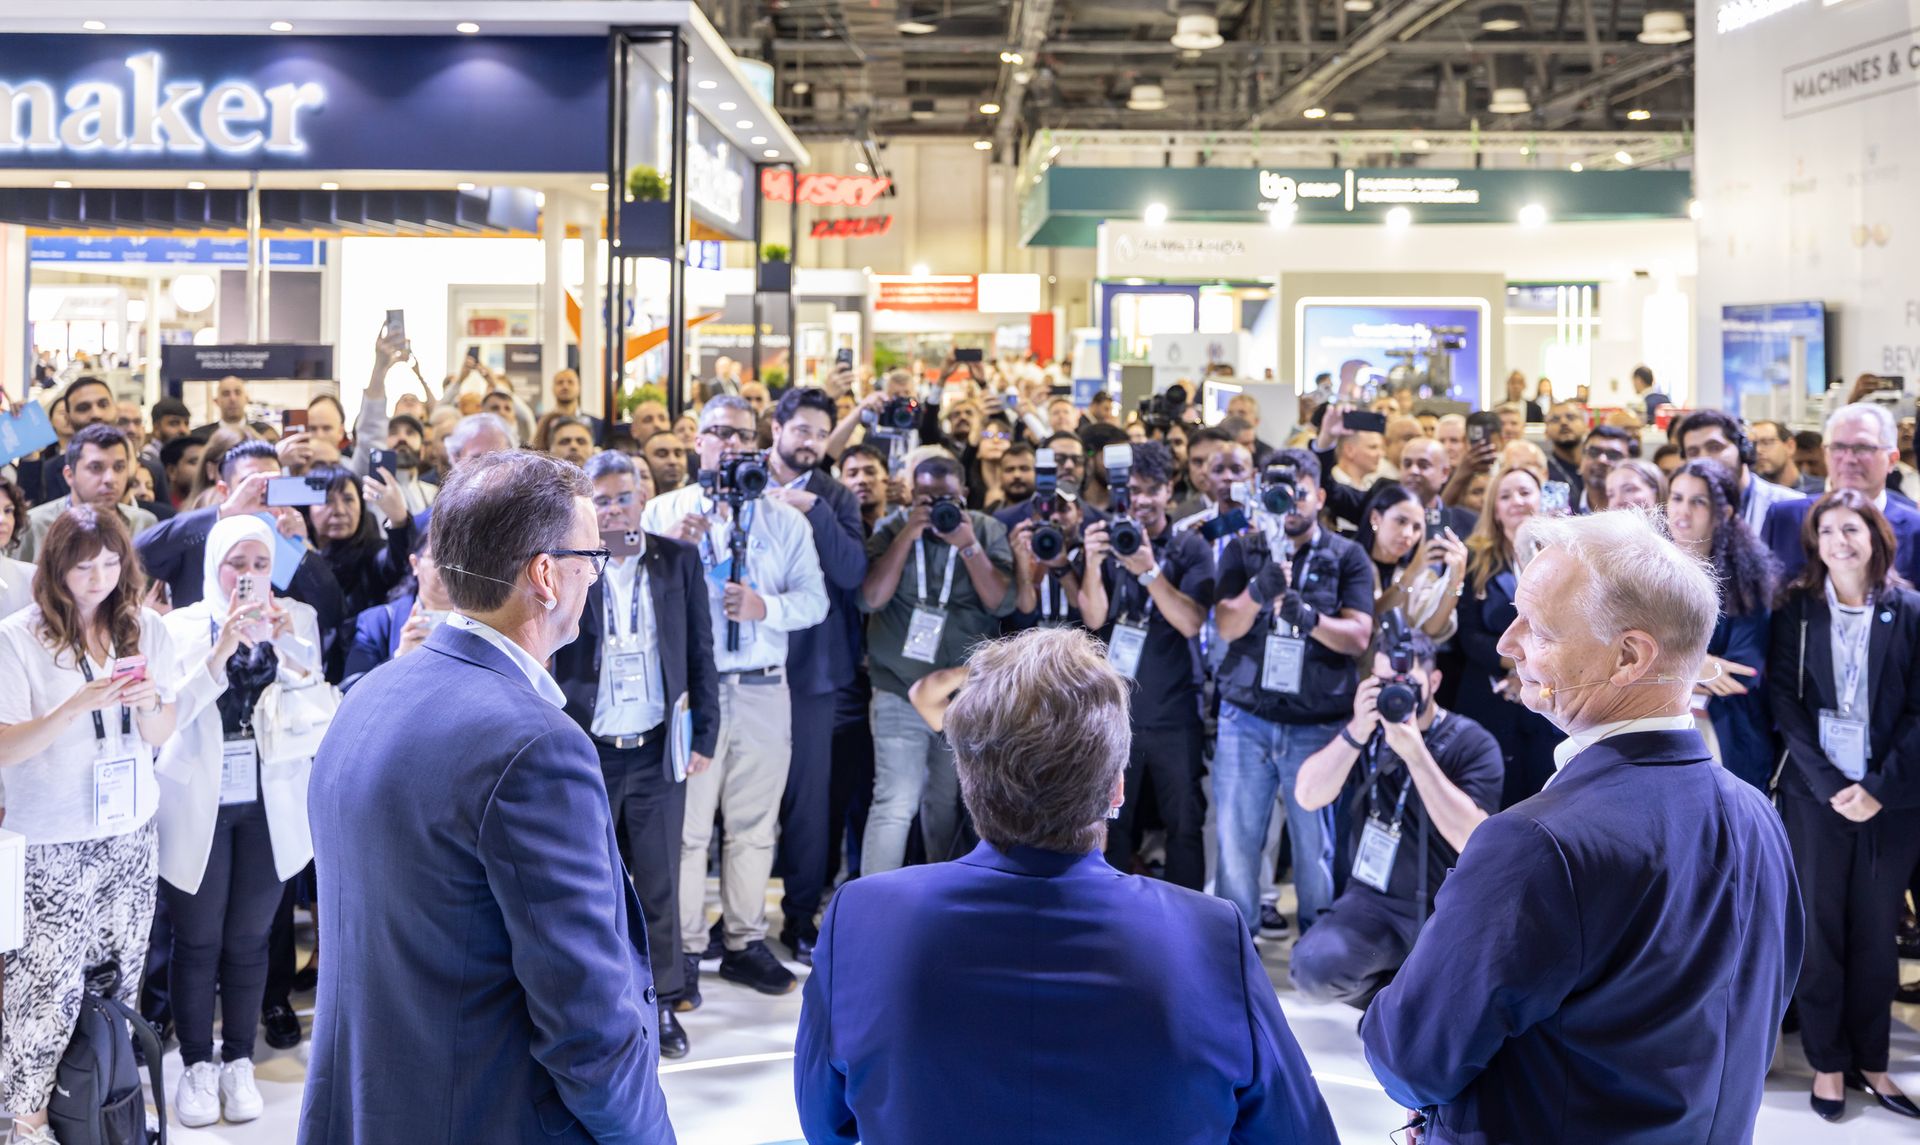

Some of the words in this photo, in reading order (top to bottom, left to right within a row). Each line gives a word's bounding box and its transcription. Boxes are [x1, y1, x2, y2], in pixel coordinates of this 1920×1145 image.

[1794, 56, 1881, 100] MACHINES
[1888, 50, 1901, 74] &
[0, 51, 324, 152] maker
[1906, 300, 1920, 327] F
